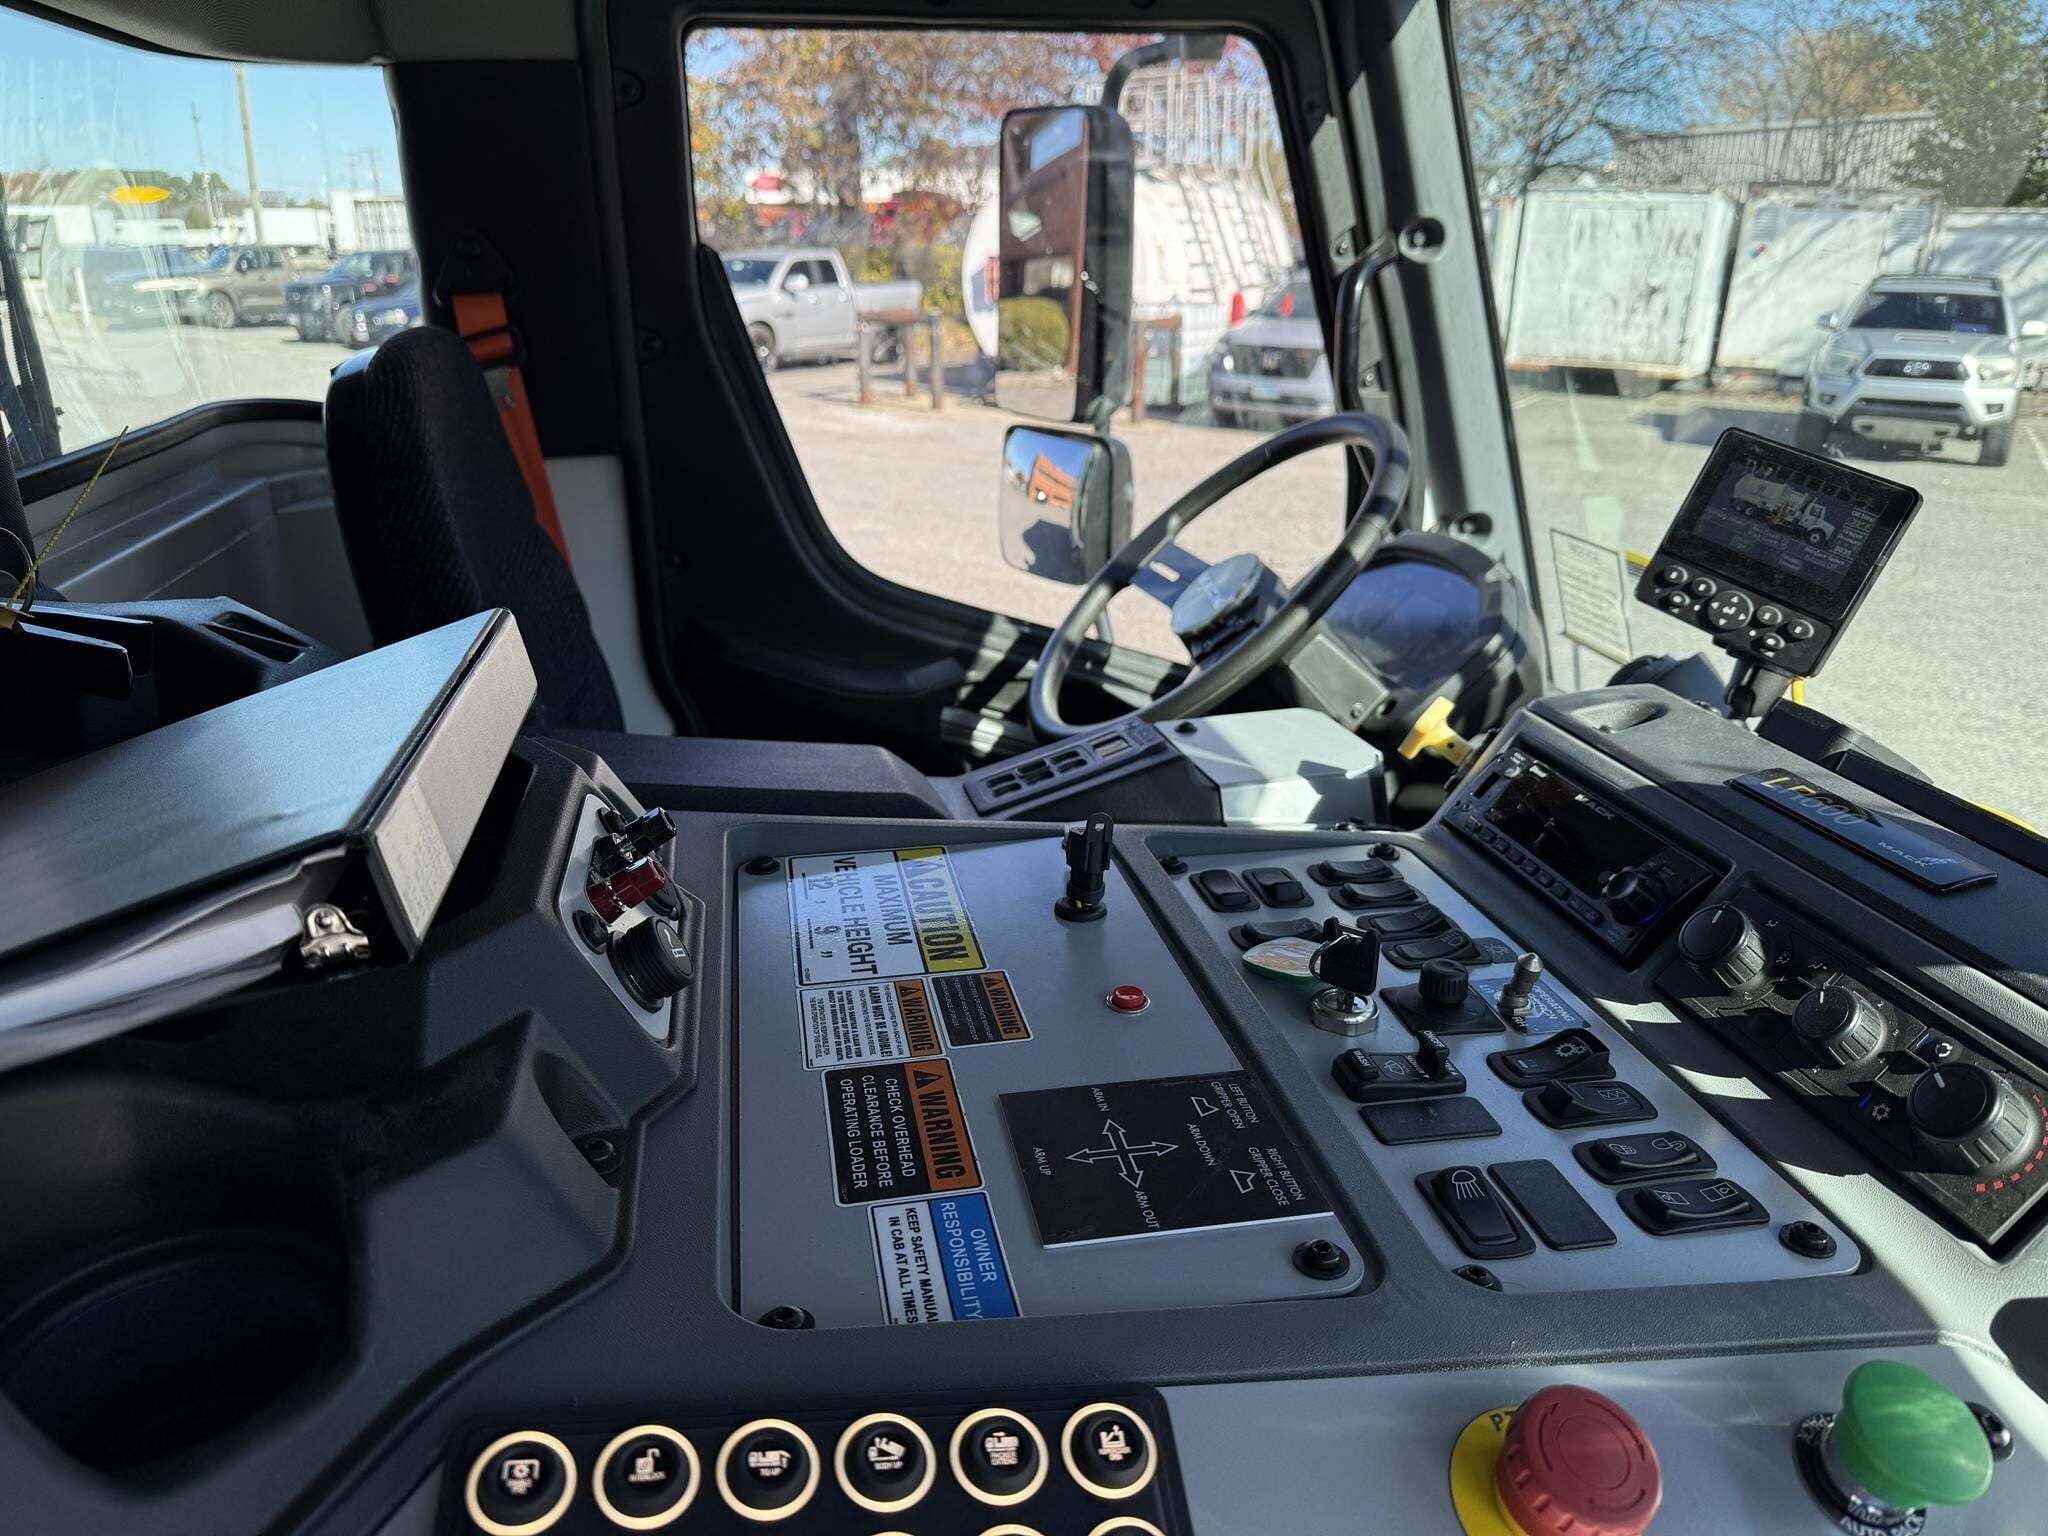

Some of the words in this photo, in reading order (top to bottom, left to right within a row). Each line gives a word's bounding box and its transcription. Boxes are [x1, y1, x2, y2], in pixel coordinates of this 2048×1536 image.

[1574, 794, 1616, 820] MACK
[1760, 776, 1866, 826] LR600
[1877, 841, 1928, 867] MACK
[832, 856, 866, 913] VEHICLE
[872, 874, 913, 945] MAXIMUM
[906, 877, 970, 961] CAUTION
[842, 916, 878, 976] HEIGHT
[867, 985, 882, 1004] ALARM
[871, 1004, 885, 1020] MUST
[987, 987, 1021, 1034] WARNING
[874, 1021, 887, 1029] BE
[900, 996, 935, 1051] WARNING
[876, 1029, 893, 1057] AUDIBLE!
[837, 1078, 863, 1137] OPERATING
[859, 1074, 886, 1137] CLEARANCE
[883, 1077, 904, 1112] CHECK
[1090, 1087, 1106, 1102] ARM
[1097, 1102, 1110, 1111] IN
[1209, 1081, 1234, 1108] GRIPPER
[1225, 1108, 1246, 1129] OPEN
[1226, 1083, 1244, 1096] LEFT
[1235, 1097, 1260, 1123] BUTTON
[889, 1114, 918, 1177] OVERHEAD
[915, 1089, 967, 1180] WARNING
[1185, 1123, 1204, 1139] ARM
[845, 1140, 870, 1189] LOADER
[870, 1139, 894, 1187] BEFORE
[1032, 1146, 1048, 1164] ARM
[1038, 1164, 1052, 1175] UP
[1194, 1139, 1218, 1166] DOWN
[1246, 1146, 1274, 1177] GRIPPER
[1264, 1178, 1290, 1206] CLOSE
[1264, 1147, 1287, 1168] RIGHT
[1277, 1169, 1306, 1200] BUTTON
[1132, 1189, 1151, 1209] ARM
[888, 1216, 900, 1226] IN
[904, 1207, 921, 1233] KEEP
[1141, 1209, 1160, 1228] OUT
[890, 1228, 905, 1250] CAB
[909, 1235, 929, 1276] SAFETY
[969, 1227, 998, 1282] OWNER
[894, 1252, 907, 1265] AT
[940, 1201, 983, 1320] RESPONSIBILITY
[897, 1266, 912, 1288] ALL
[900, 1289, 919, 1323] TIMES
